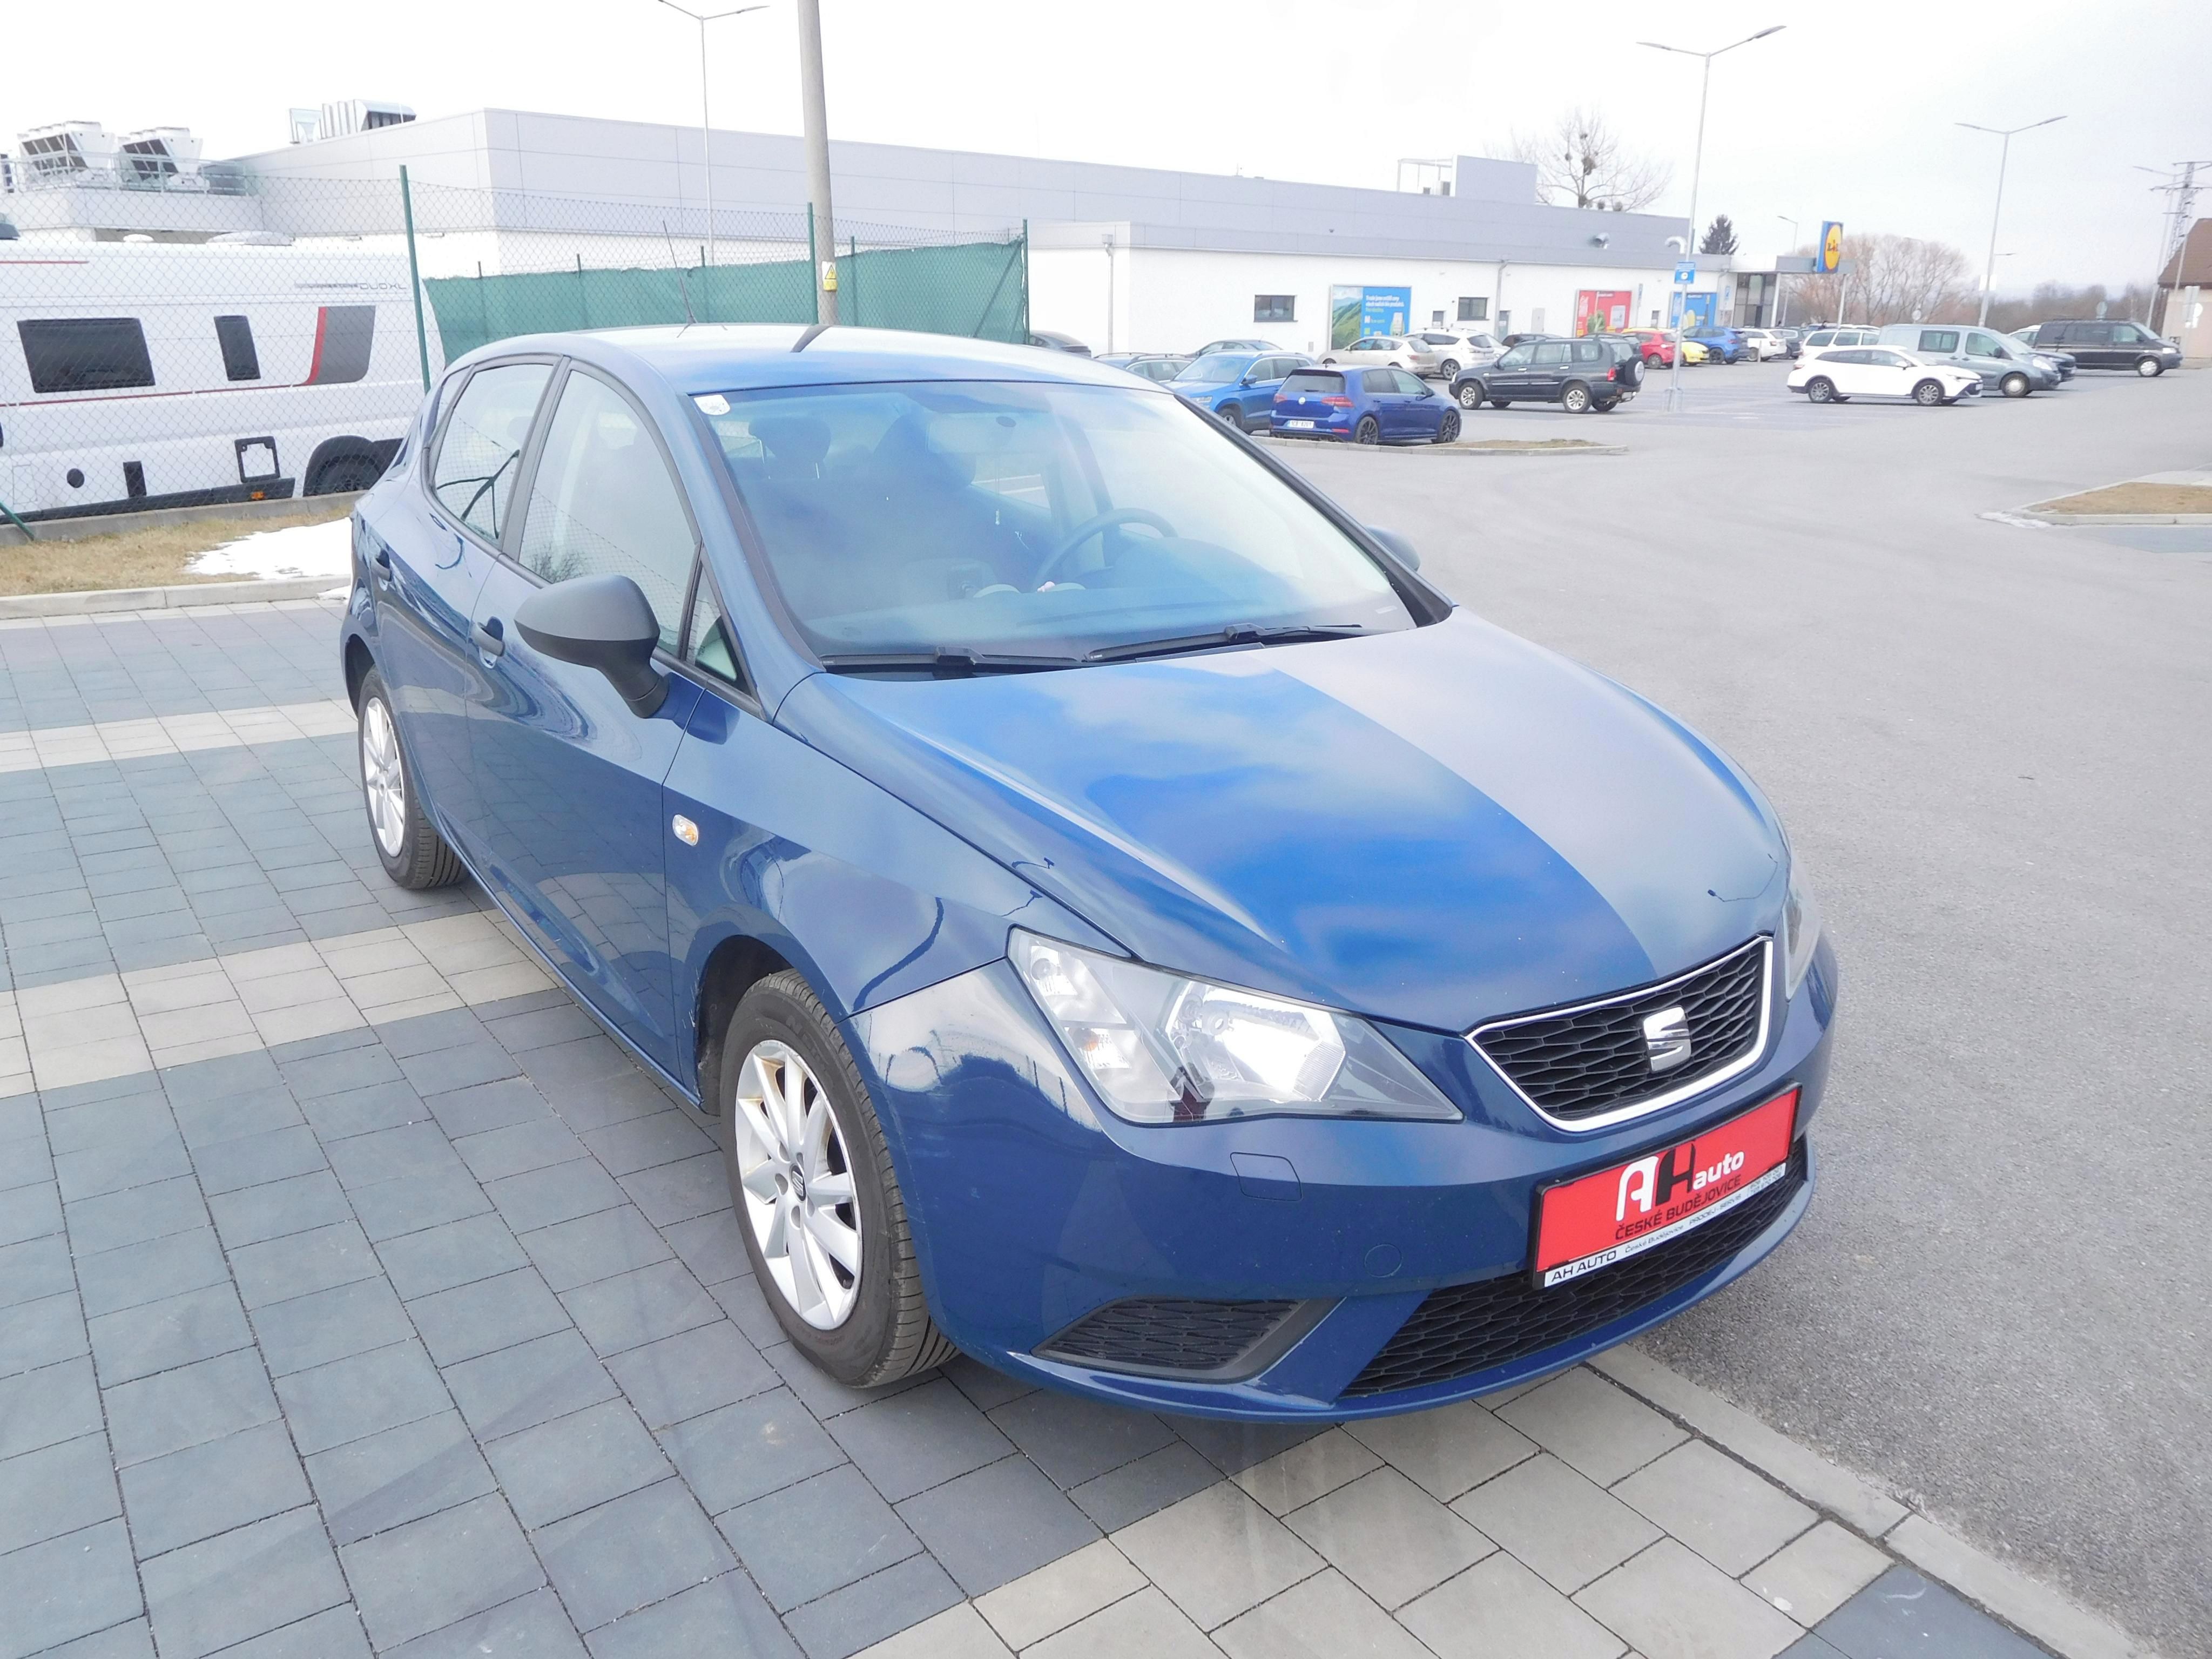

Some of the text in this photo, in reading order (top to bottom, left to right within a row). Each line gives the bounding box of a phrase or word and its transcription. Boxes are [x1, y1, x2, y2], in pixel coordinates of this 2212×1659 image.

[1615, 1209, 1662, 1240] ČESKÉ
[1666, 1175, 1741, 1220] BUDĚJOVICE
[1616, 1142, 1696, 1222] AH
[1692, 1151, 1745, 1190] auto
[1551, 1260, 1574, 1283] AH
[1576, 1250, 1617, 1274] AUTO
